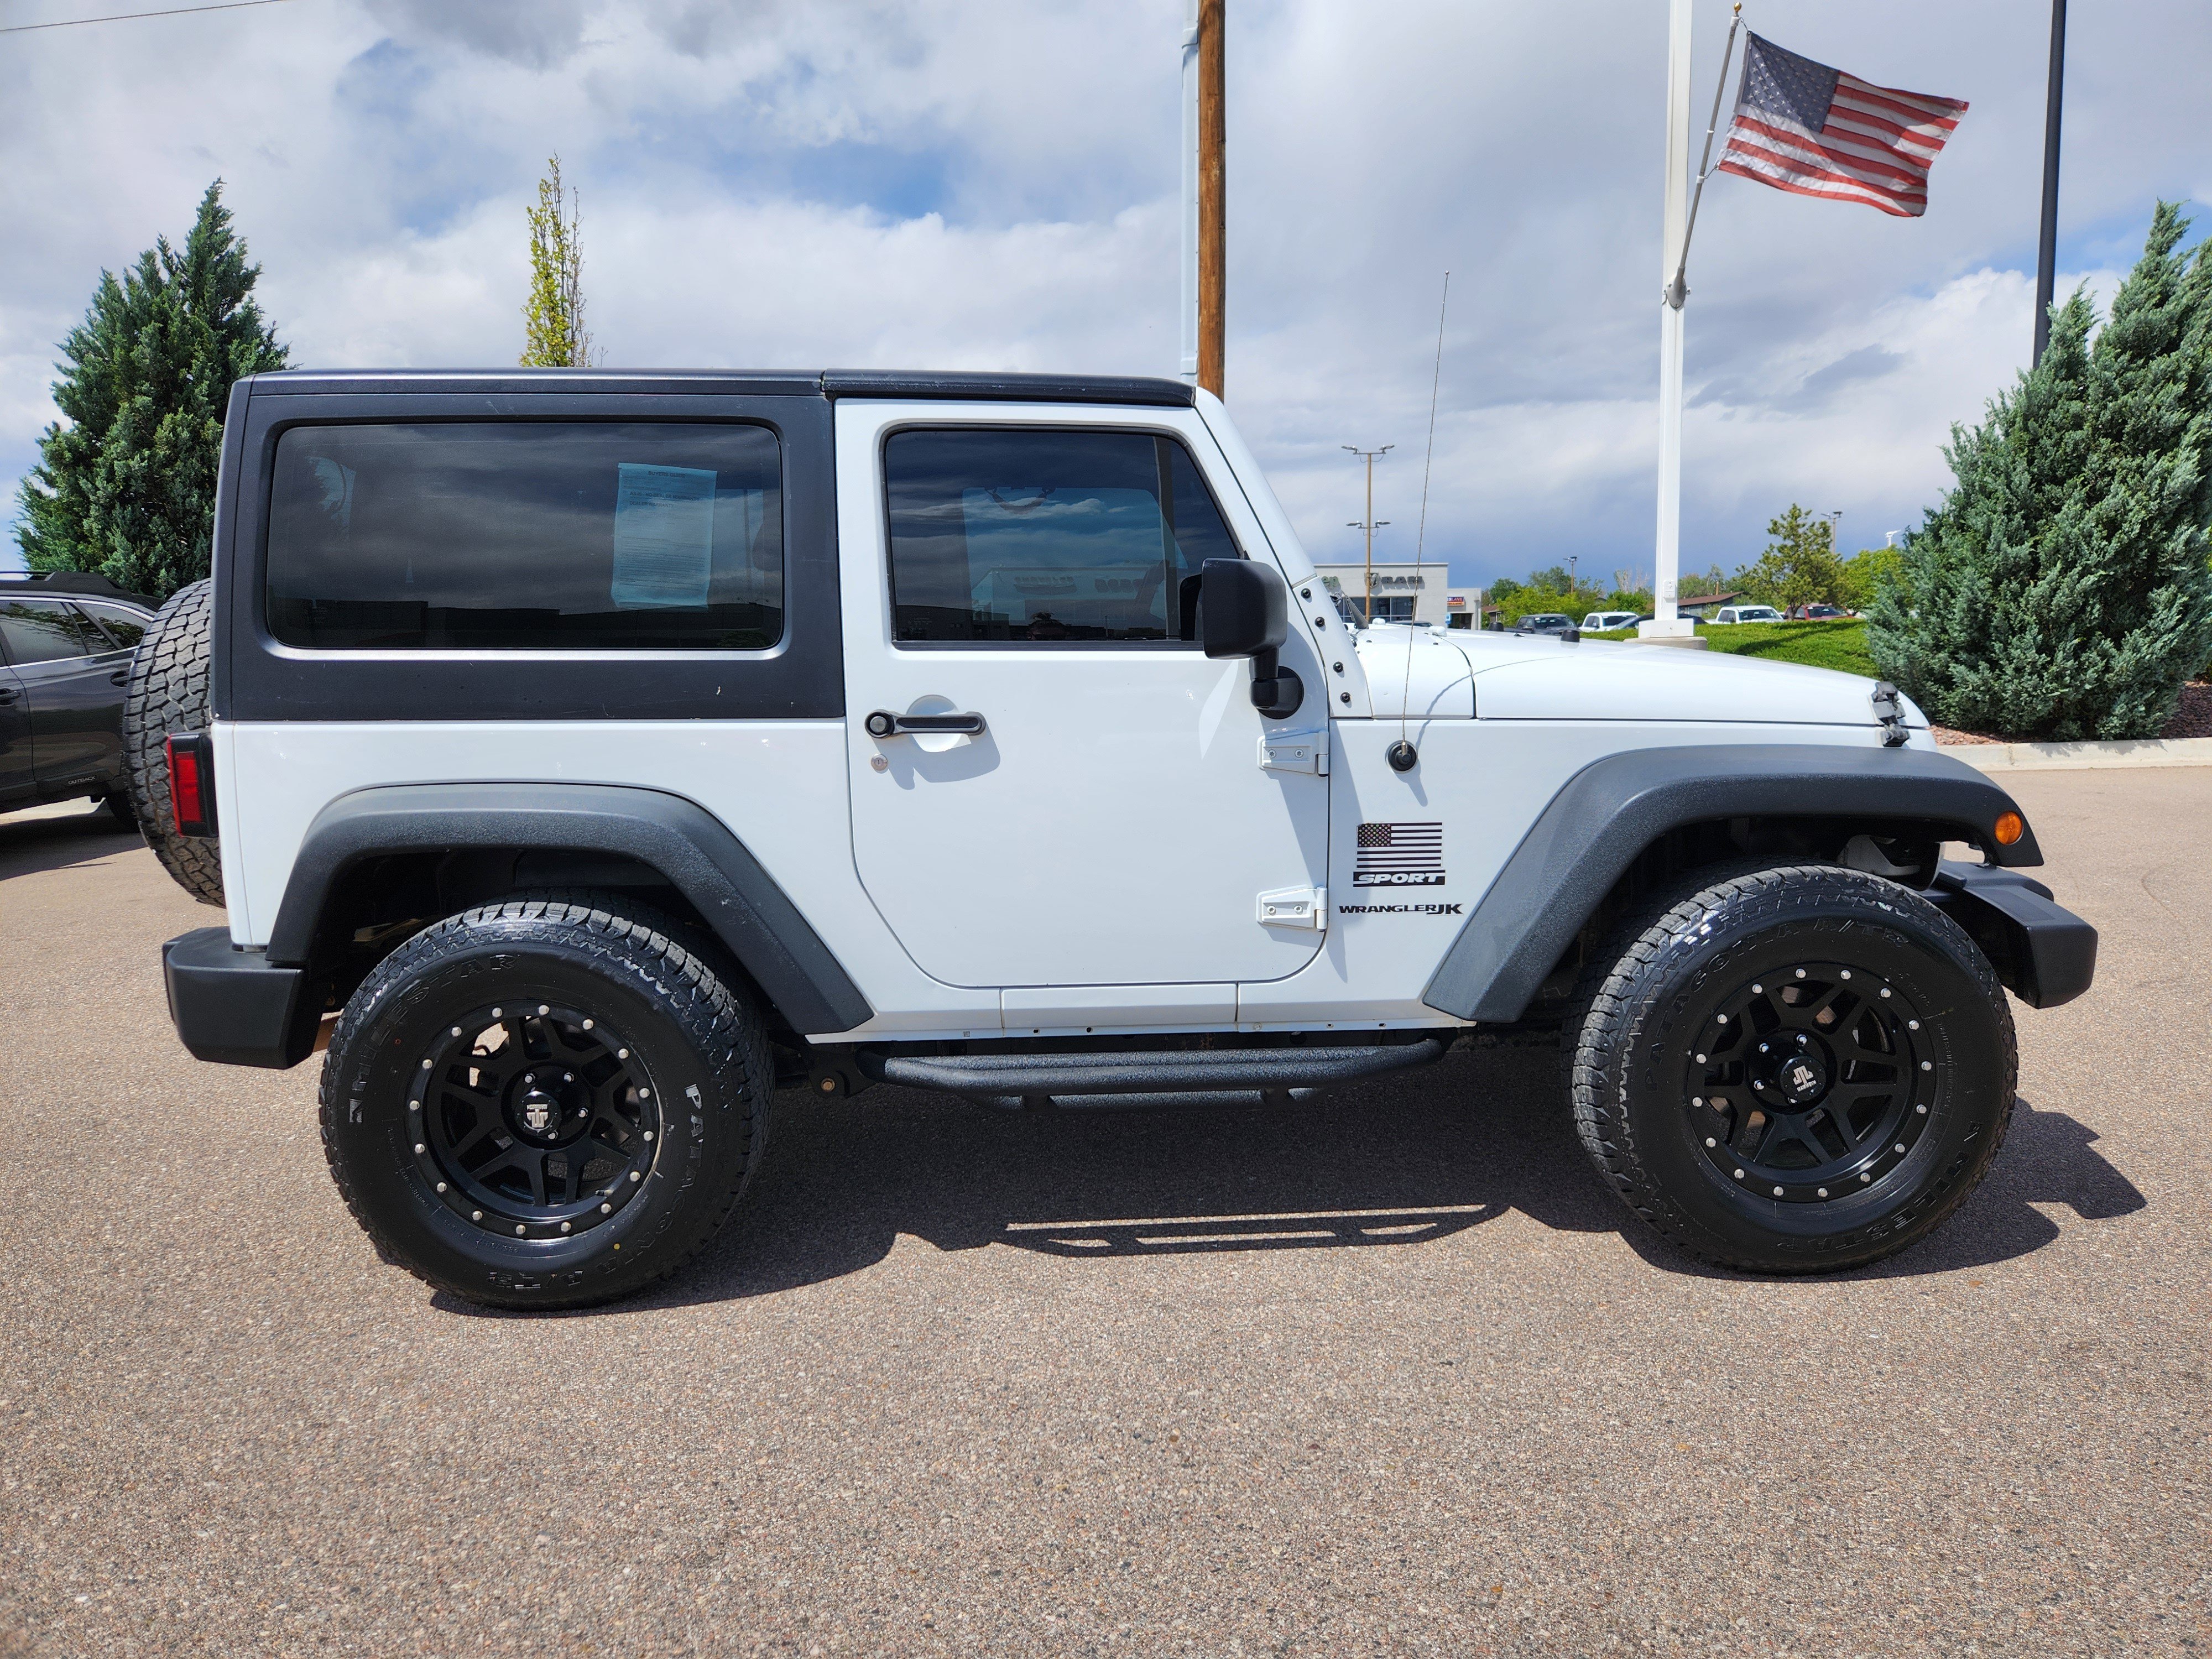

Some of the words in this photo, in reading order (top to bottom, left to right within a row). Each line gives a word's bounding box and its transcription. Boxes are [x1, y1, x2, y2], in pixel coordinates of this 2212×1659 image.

[1381, 576, 1423, 585] RAM
[68, 776, 96, 785] OUTBACK
[1354, 873, 1446, 885] SPORT
